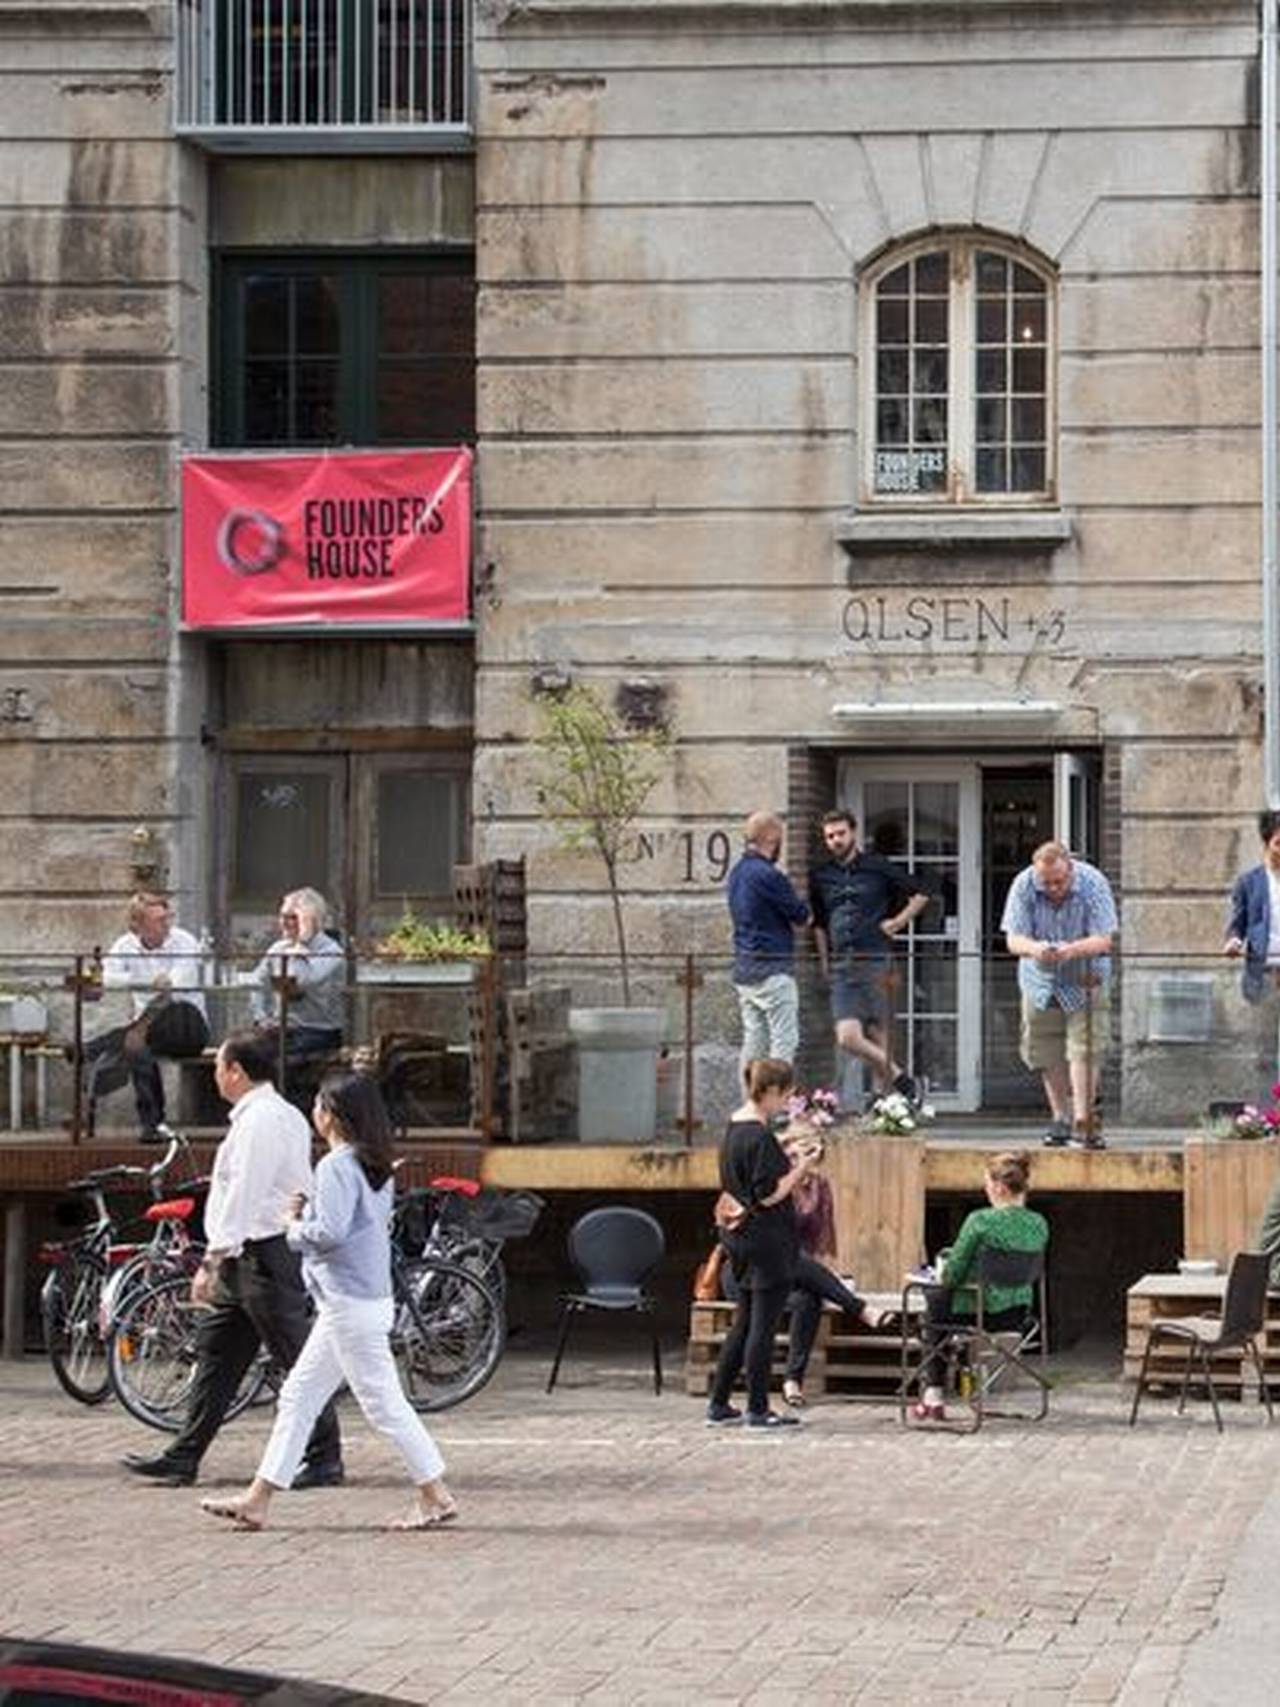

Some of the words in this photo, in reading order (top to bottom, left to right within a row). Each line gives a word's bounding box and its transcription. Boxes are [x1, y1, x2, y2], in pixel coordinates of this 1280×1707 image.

[305, 498, 444, 537] FOUNDERS
[306, 539, 395, 578] HOUSE
[681, 829, 731, 883] 19
